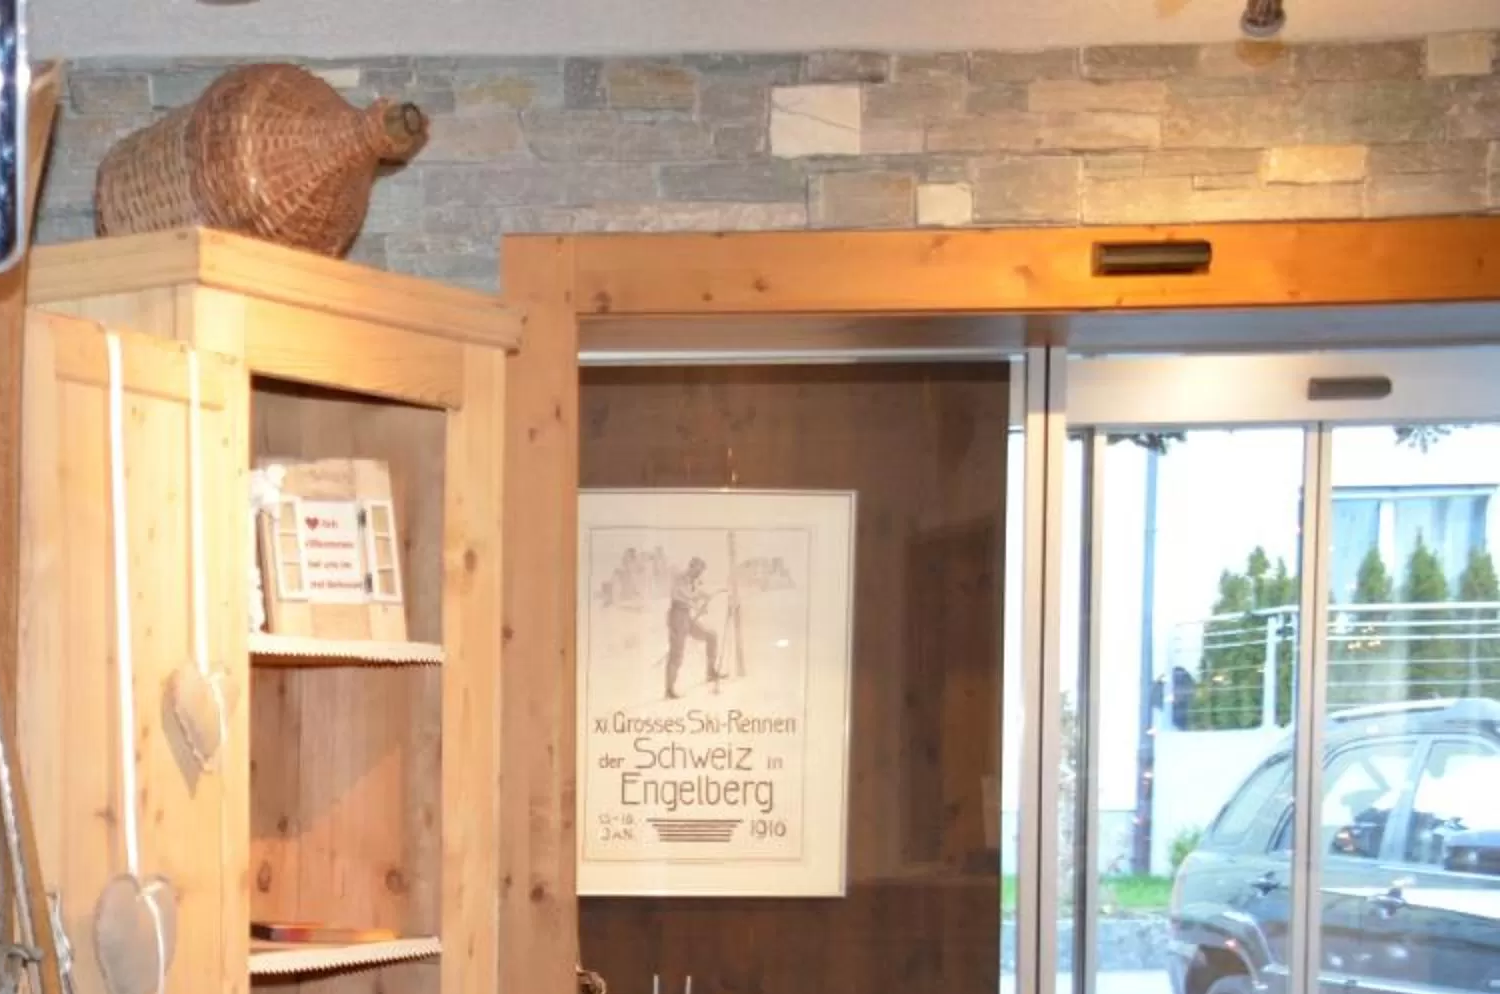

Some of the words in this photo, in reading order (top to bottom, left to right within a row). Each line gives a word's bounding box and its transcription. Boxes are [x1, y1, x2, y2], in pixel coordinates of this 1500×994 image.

[612, 710, 685, 735] Grosses
[599, 752, 625, 769] der
[633, 737, 753, 771] Schweiz
[766, 754, 784, 770] in
[621, 771, 774, 814] Engelberg
